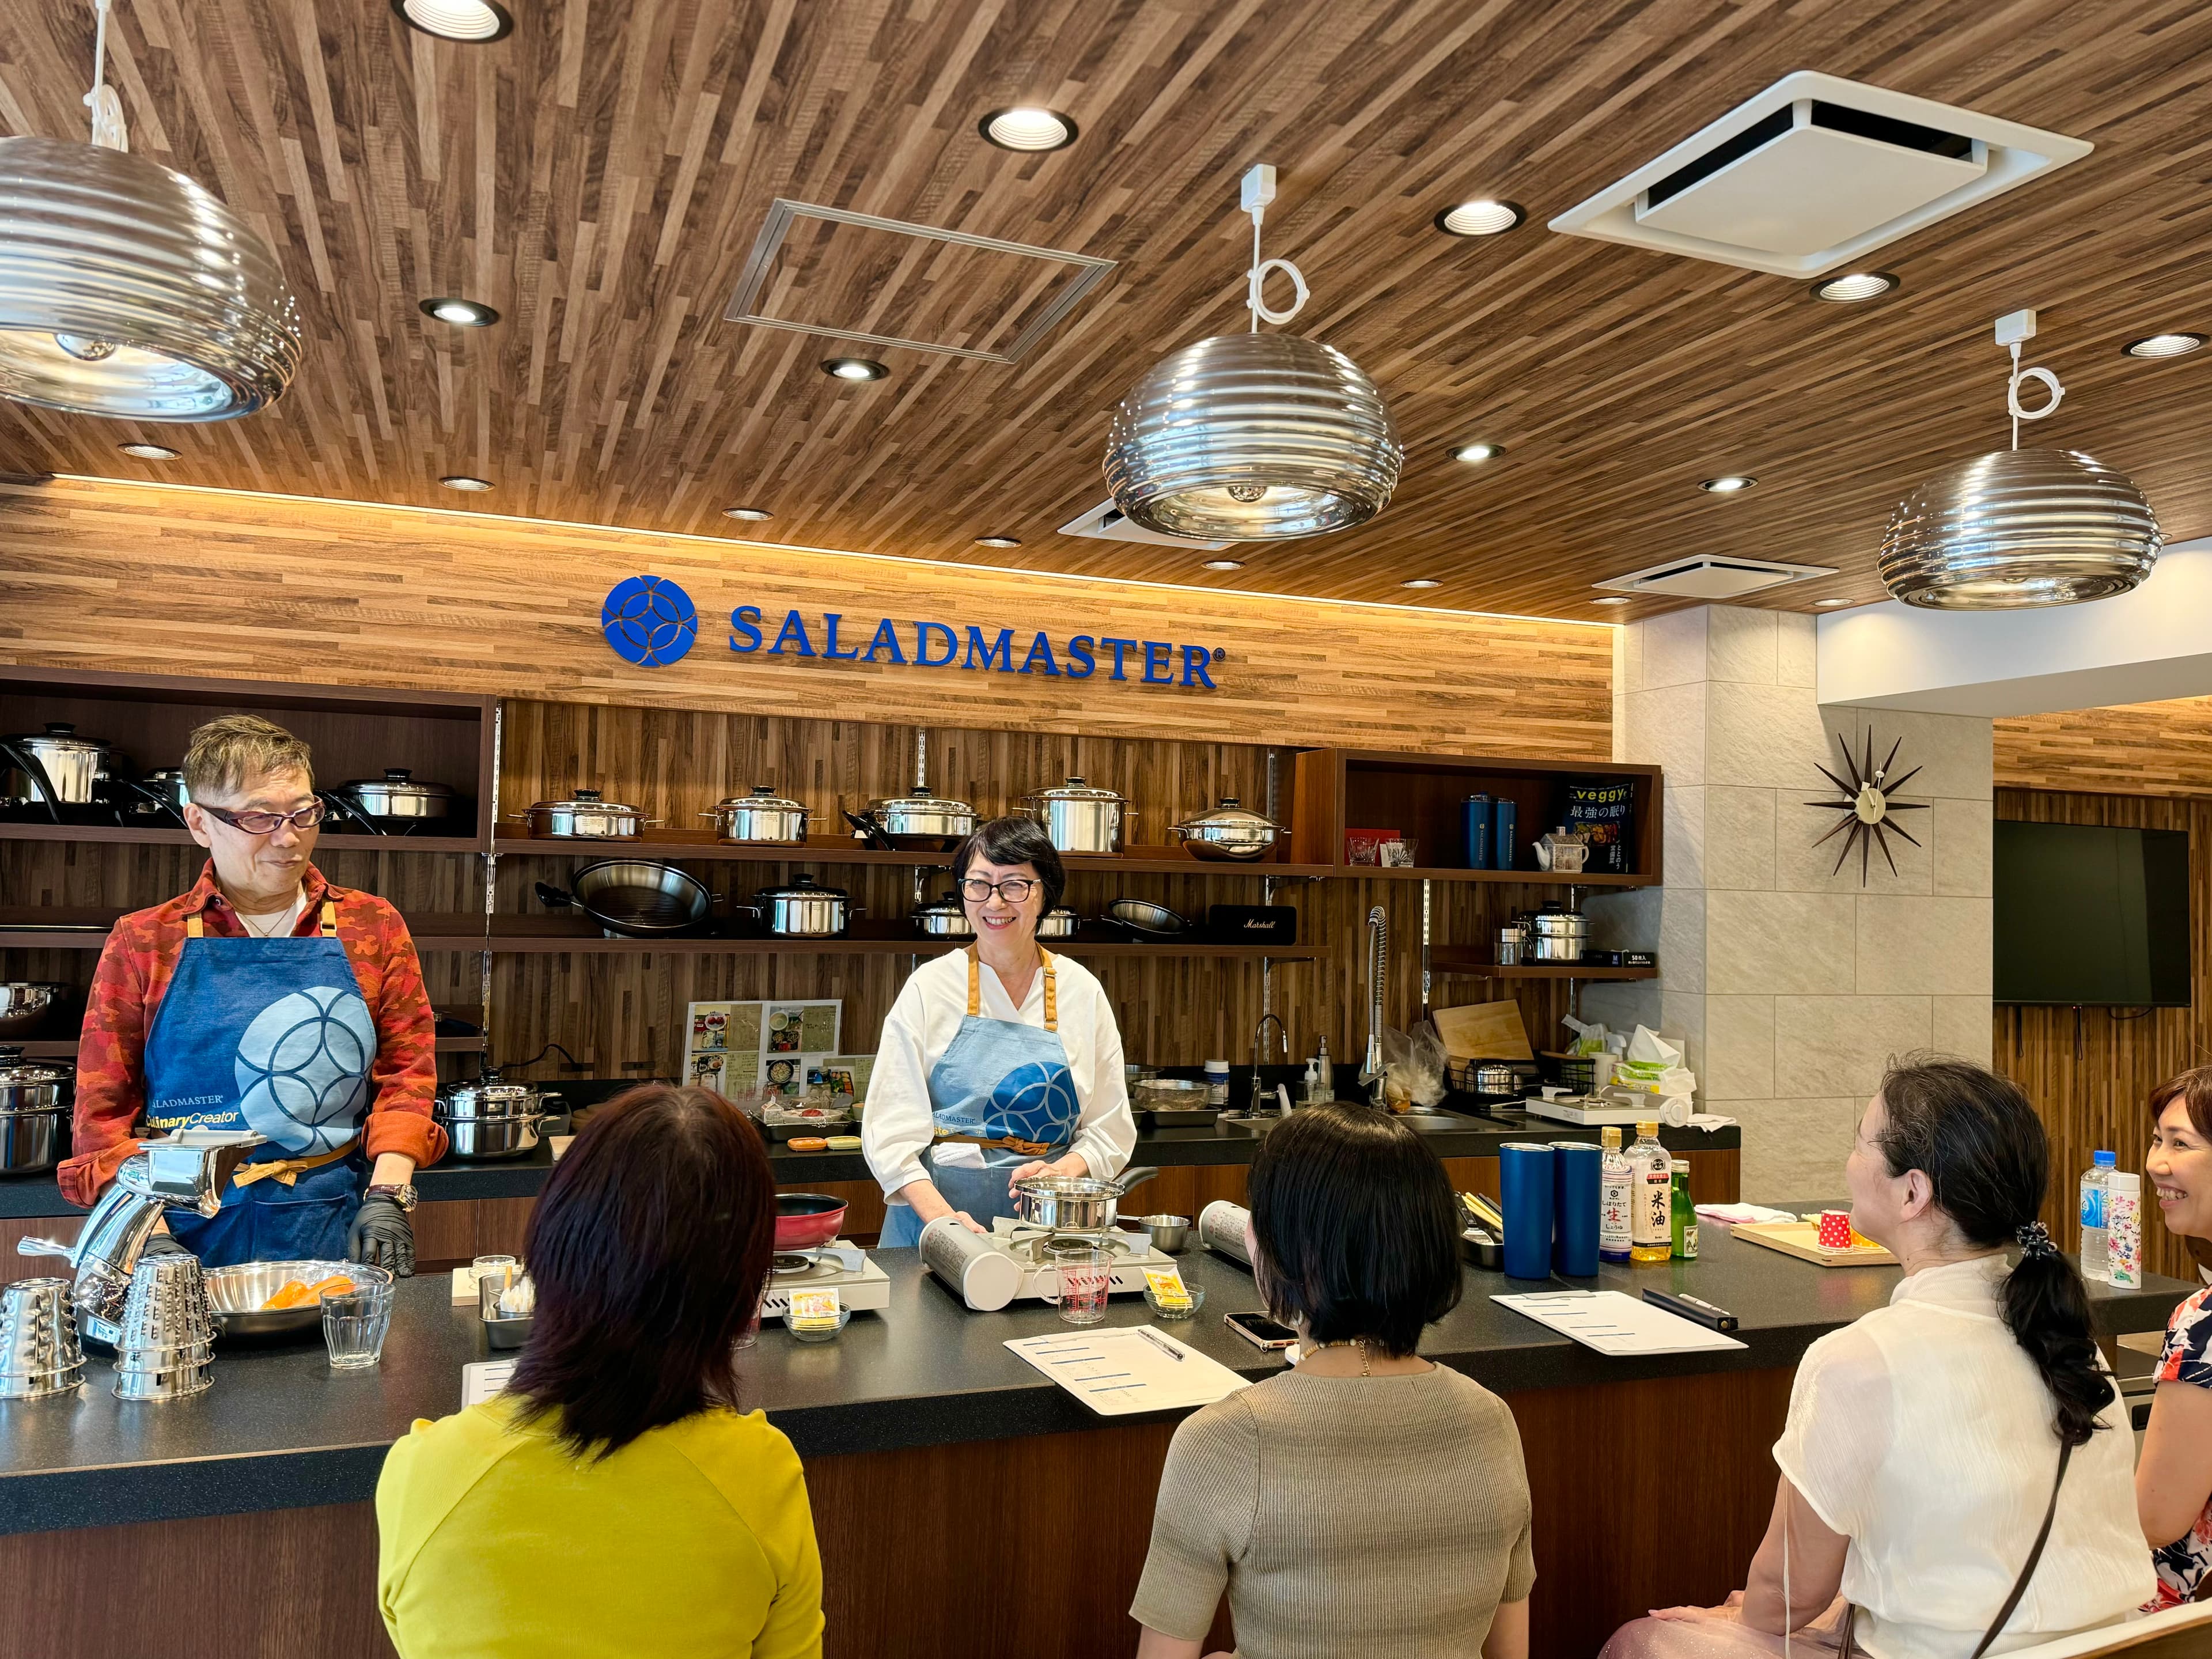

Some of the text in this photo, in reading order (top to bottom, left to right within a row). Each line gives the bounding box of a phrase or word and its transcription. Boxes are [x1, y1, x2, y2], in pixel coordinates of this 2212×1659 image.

[1577, 788, 1624, 803] veggy
[1570, 805, 1625, 819] 最強の眠り
[1244, 919, 1276, 929] Marshall
[152, 1095, 224, 1108] ALADMASTER
[1607, 1207, 1622, 1222] 生
[1651, 1190, 1665, 1228] 米油
